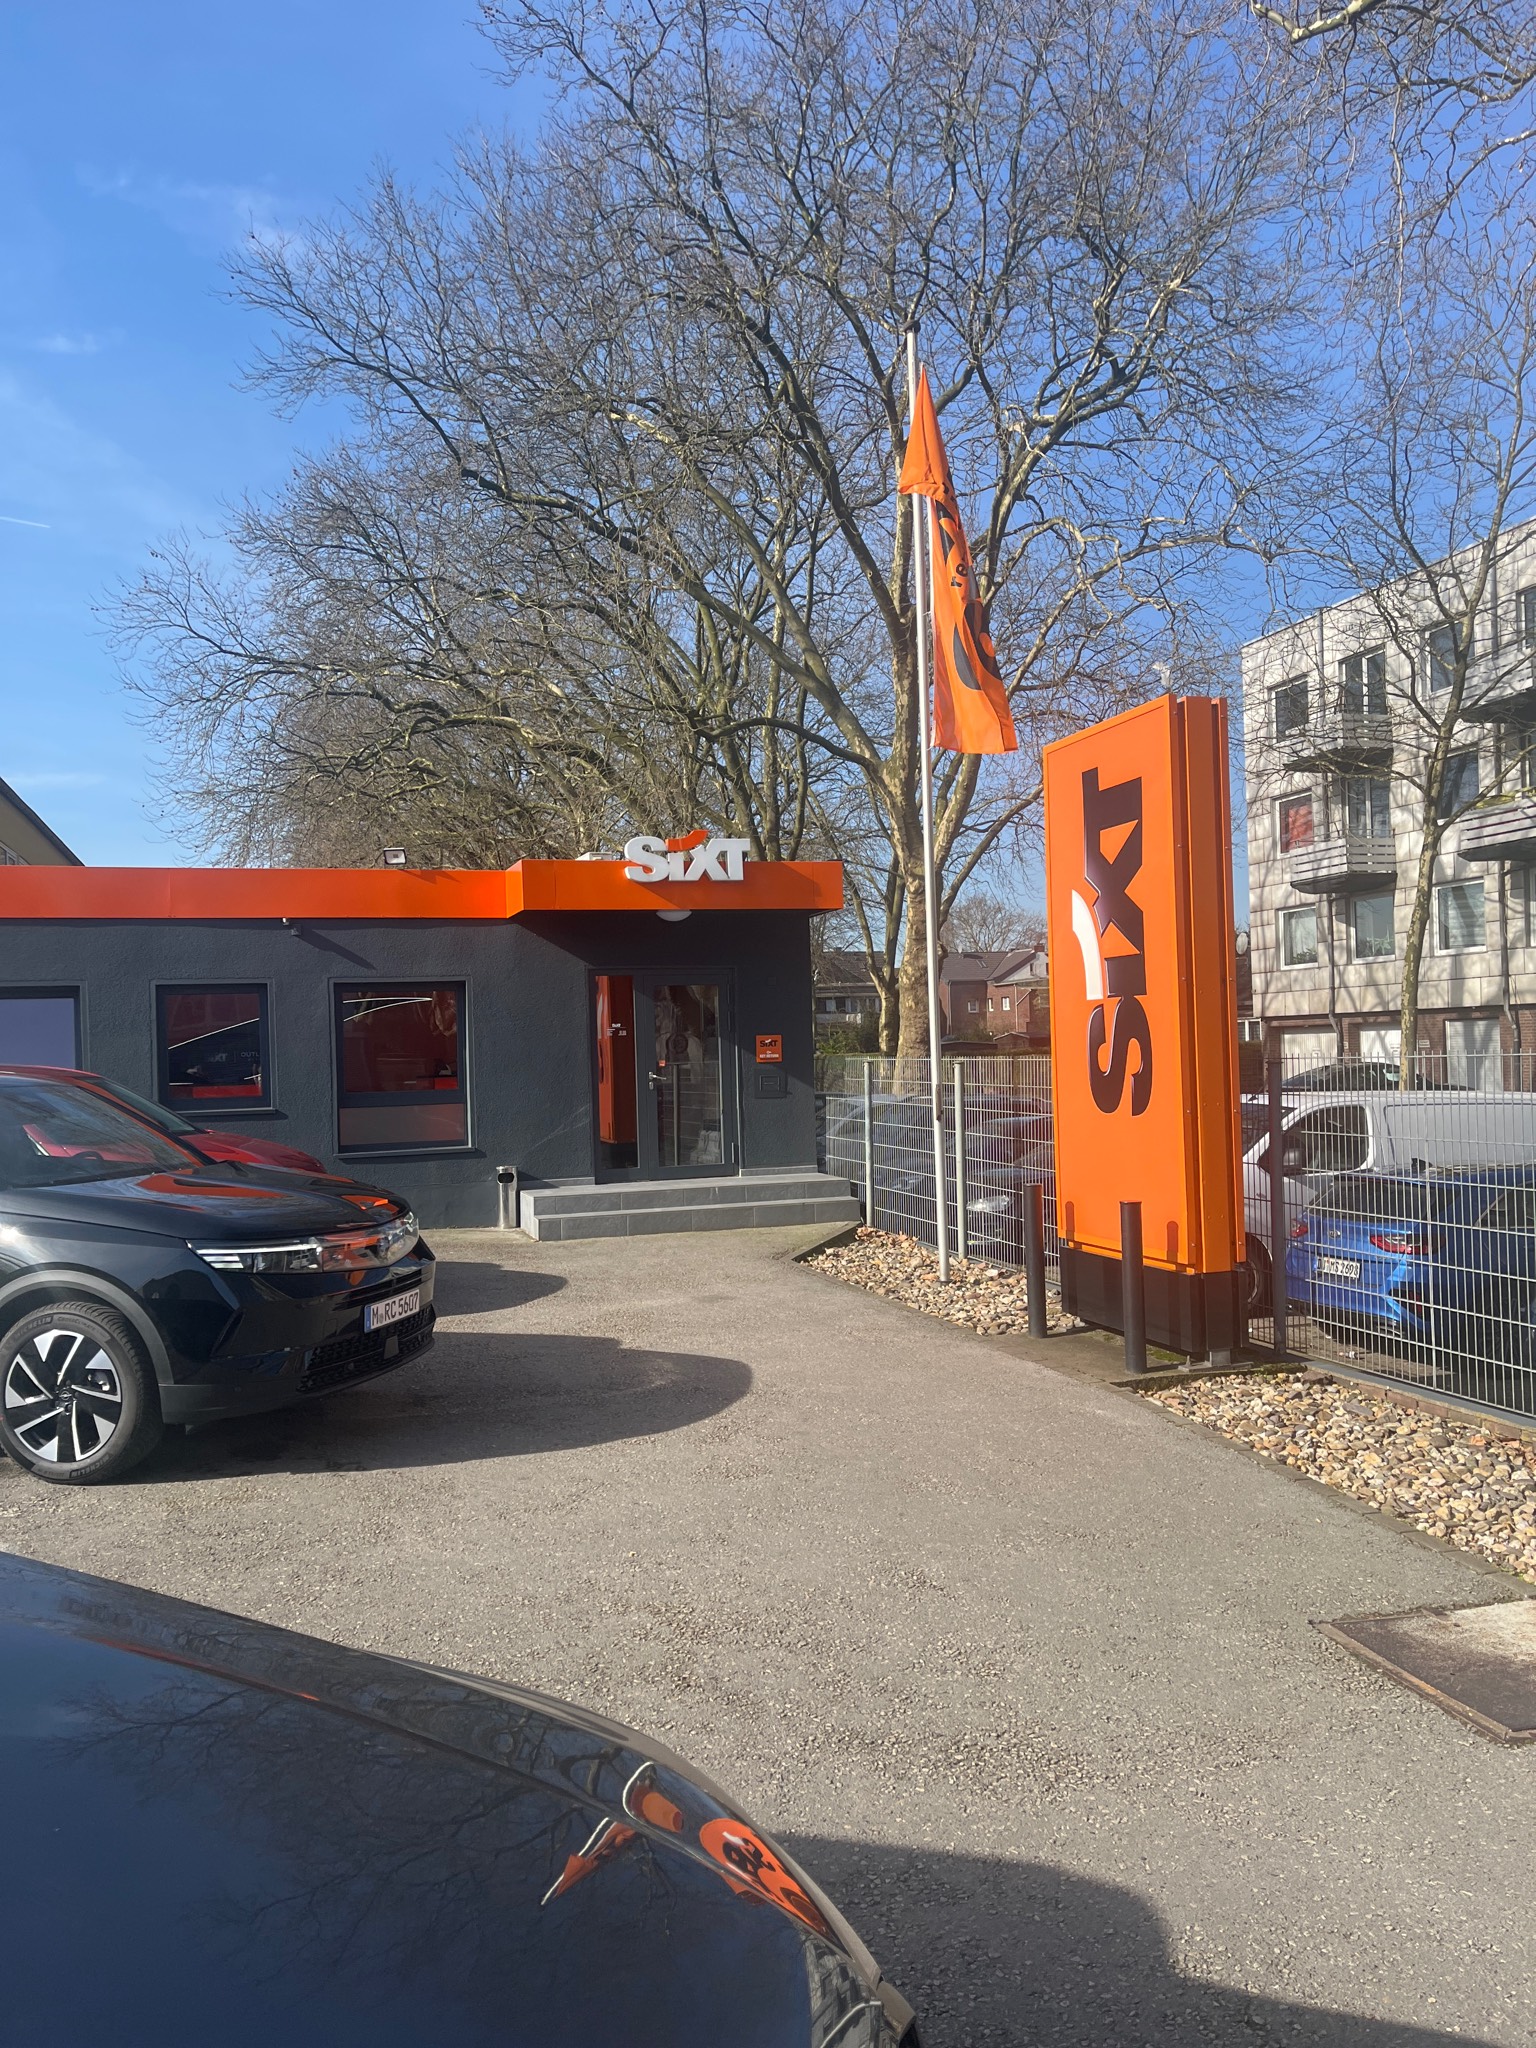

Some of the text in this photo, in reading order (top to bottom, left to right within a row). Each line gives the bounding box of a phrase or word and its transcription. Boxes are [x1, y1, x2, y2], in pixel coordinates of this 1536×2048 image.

[372, 1291, 419, 1326] M RC 5607
